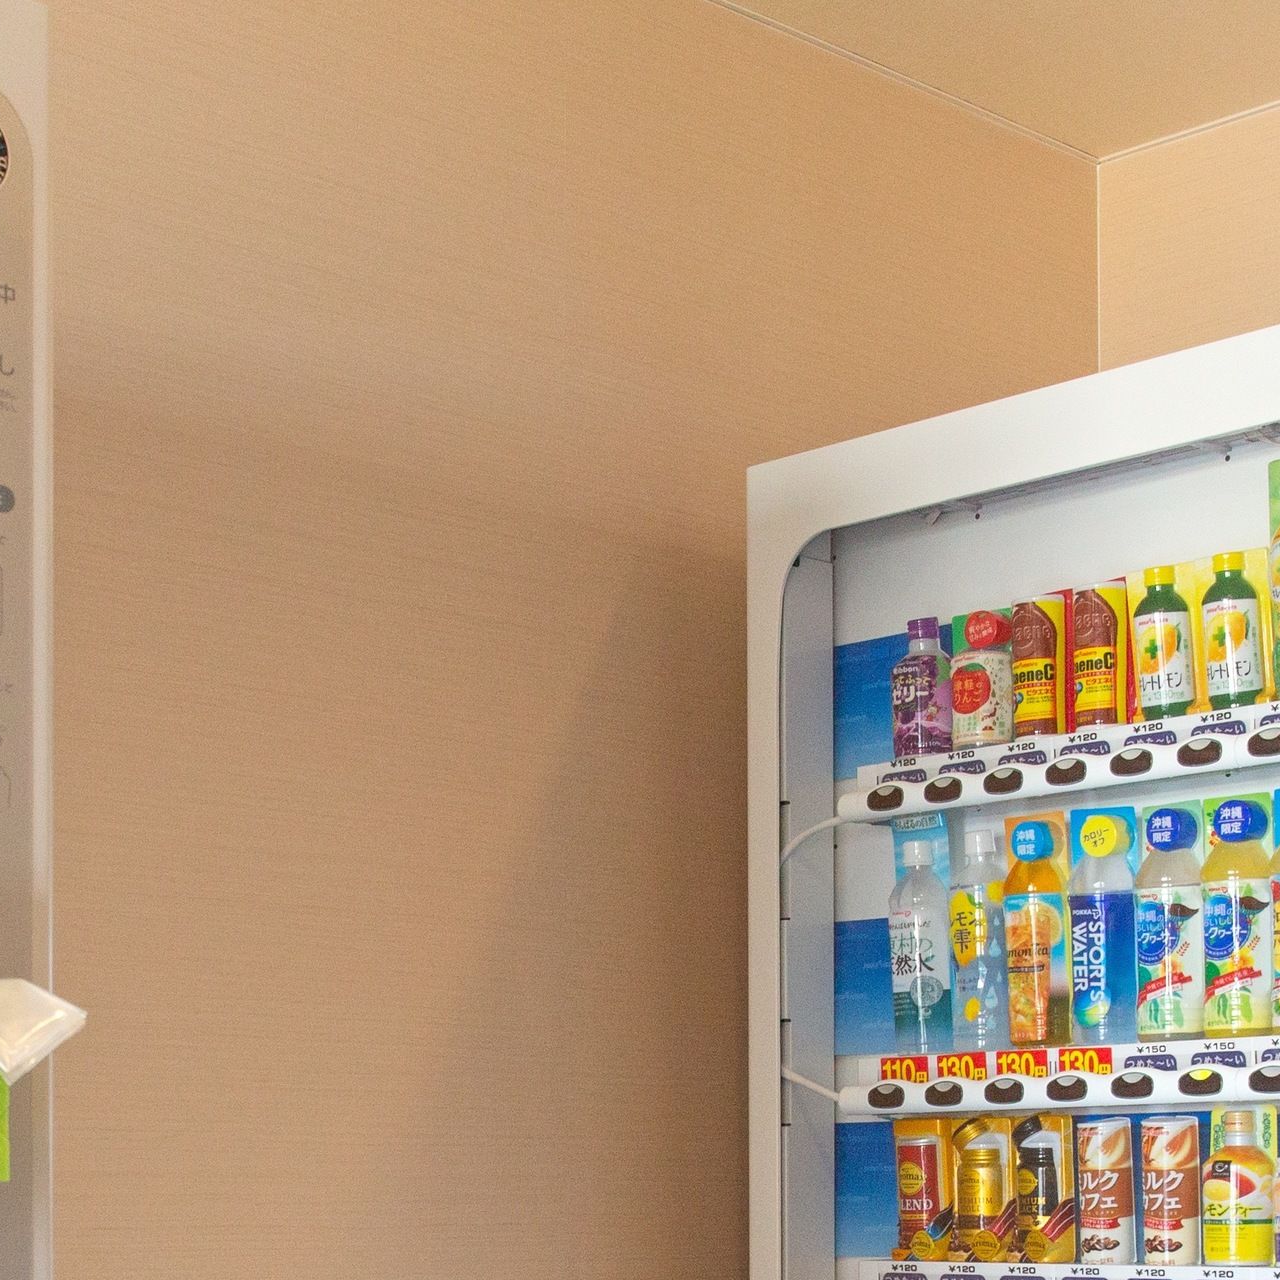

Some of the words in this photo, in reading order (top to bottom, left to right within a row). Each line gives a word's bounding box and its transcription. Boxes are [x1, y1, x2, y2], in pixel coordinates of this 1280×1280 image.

[1200, 711, 1232, 723] ¥120
[1133, 721, 1163, 733] ¥120
[1068, 732, 1098, 743] ¥120
[1007, 741, 1036, 753] ¥120
[947, 750, 975, 761] ¥120
[890, 757, 917, 769] ¥120
[1219, 806, 1243, 819] 沖縄
[1151, 816, 1172, 829] 沖縄
[1220, 822, 1242, 835] 限定
[1016, 829, 1036, 842] 沖縄
[1083, 828, 1110, 842] カロリー
[1152, 831, 1172, 843] 限定
[1092, 837, 1106, 848] オフ
[1016, 843, 1036, 856] 限定
[1072, 921, 1088, 992] WATER
[1088, 921, 1106, 1002] SPORTS
[1136, 1045, 1167, 1054] ¥150
[1204, 1041, 1235, 1050] ¥150
[938, 1055, 986, 1081] 130円
[998, 1053, 1047, 1078] 130円
[1060, 1050, 1112, 1075] 130円
[882, 1058, 927, 1083] 110円
[971, 1240, 999, 1249] aromax
[891, 1264, 918, 1273] ¥120
[948, 1265, 976, 1274] ¥120
[1008, 1265, 1036, 1275] ¥120
[1071, 1267, 1100, 1276] ¥120
[1135, 1268, 1166, 1277] ¥120
[1203, 1269, 1235, 1279] ¥120
